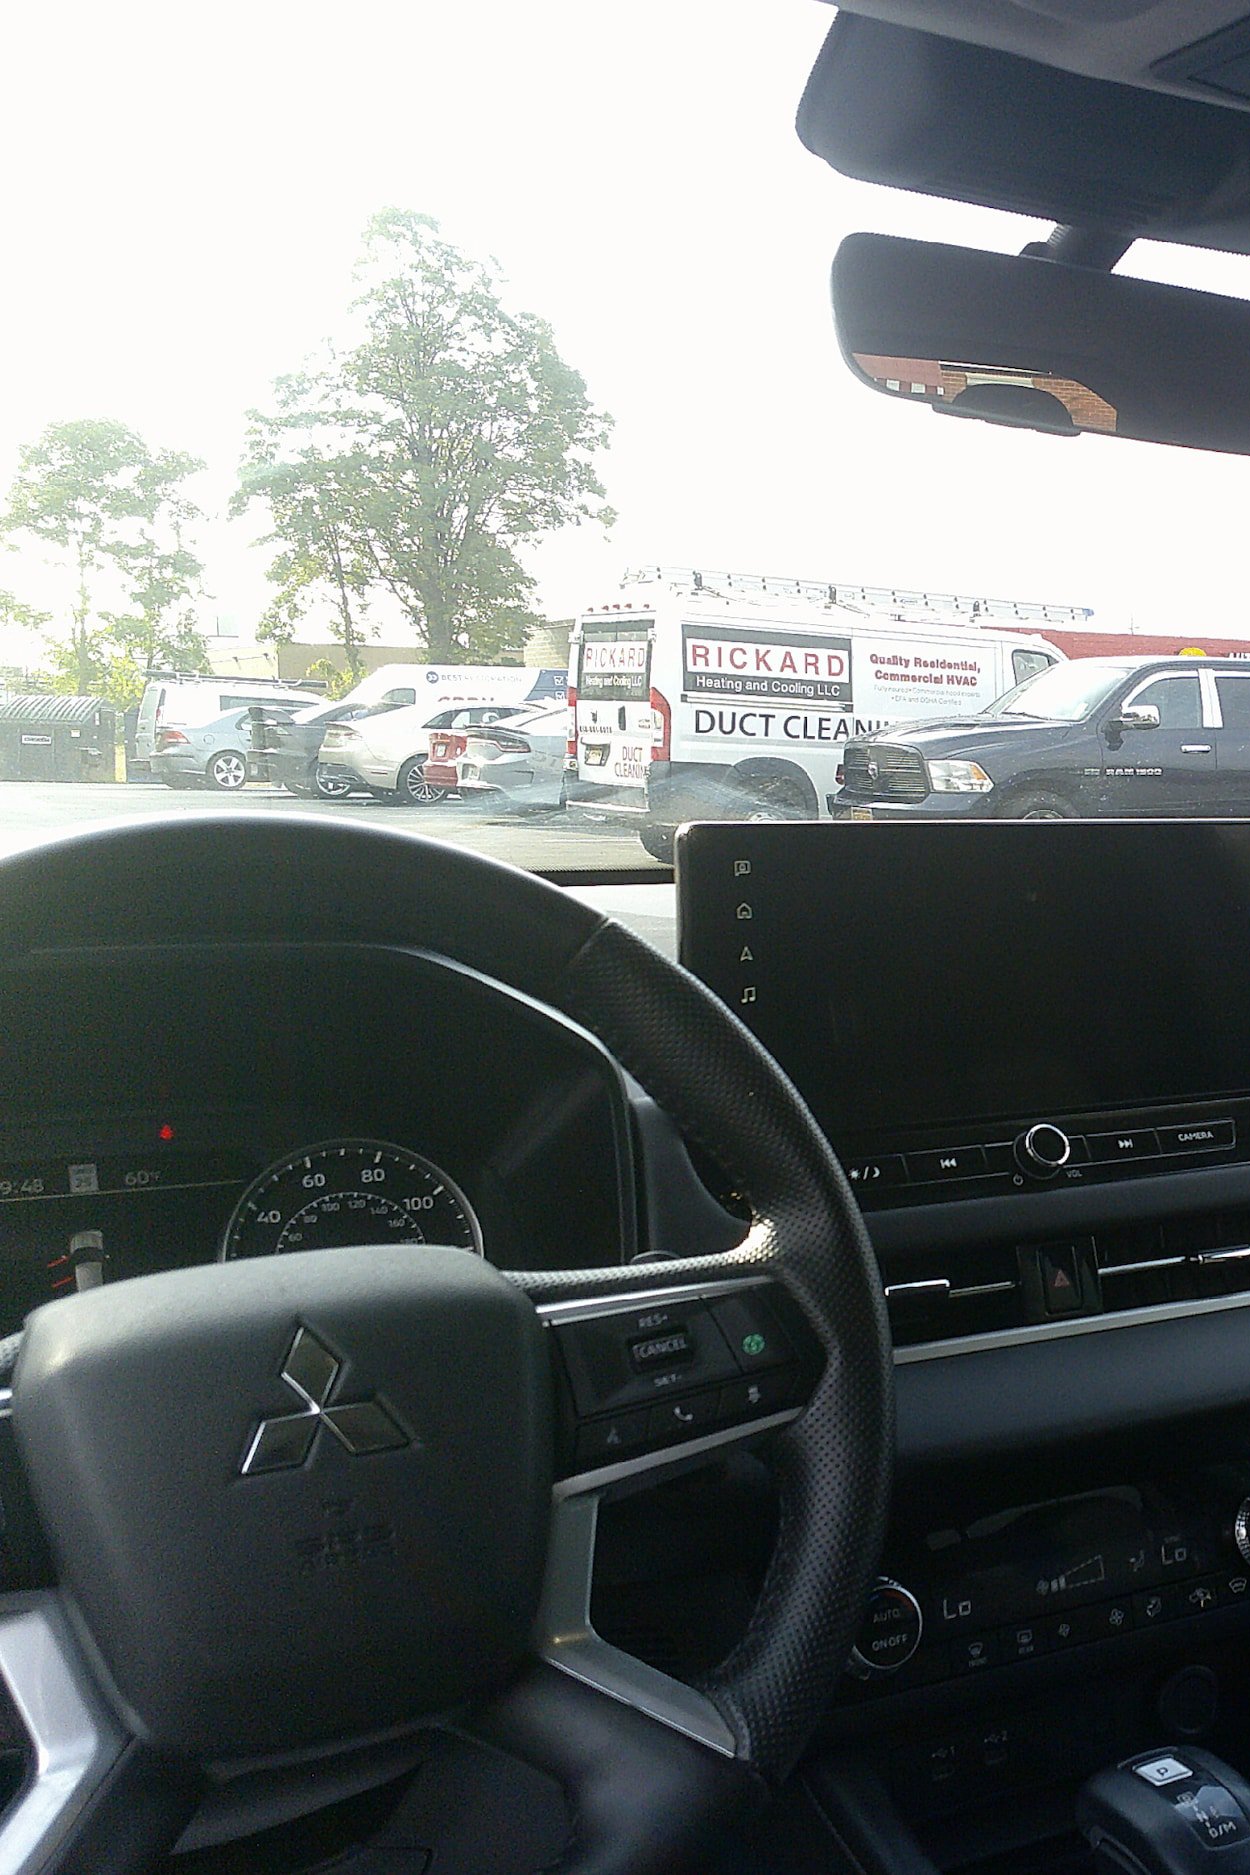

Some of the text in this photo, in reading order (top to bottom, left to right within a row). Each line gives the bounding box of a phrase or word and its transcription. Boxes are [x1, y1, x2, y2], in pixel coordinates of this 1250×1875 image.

[586, 647, 645, 668] RICKARD
[692, 644, 844, 677] RICKARD
[870, 653, 981, 674] Quality Residential,
[696, 675, 841, 697] Heating and Cooling LLC
[874, 669, 978, 687] Commercial HVAC
[695, 709, 890, 741] DUCT CLEAN
[622, 746, 643, 762] DUCT
[1178, 1130, 1214, 1142] CAMERA
[302, 1173, 326, 1189] 60
[361, 1168, 385, 1183] 80
[403, 1196, 434, 1211] 100
[257, 1210, 281, 1224] 40
[1161, 1545, 1187, 1565] Lo
[873, 1608, 901, 1624] AUTO
[943, 1598, 972, 1620] Lo
